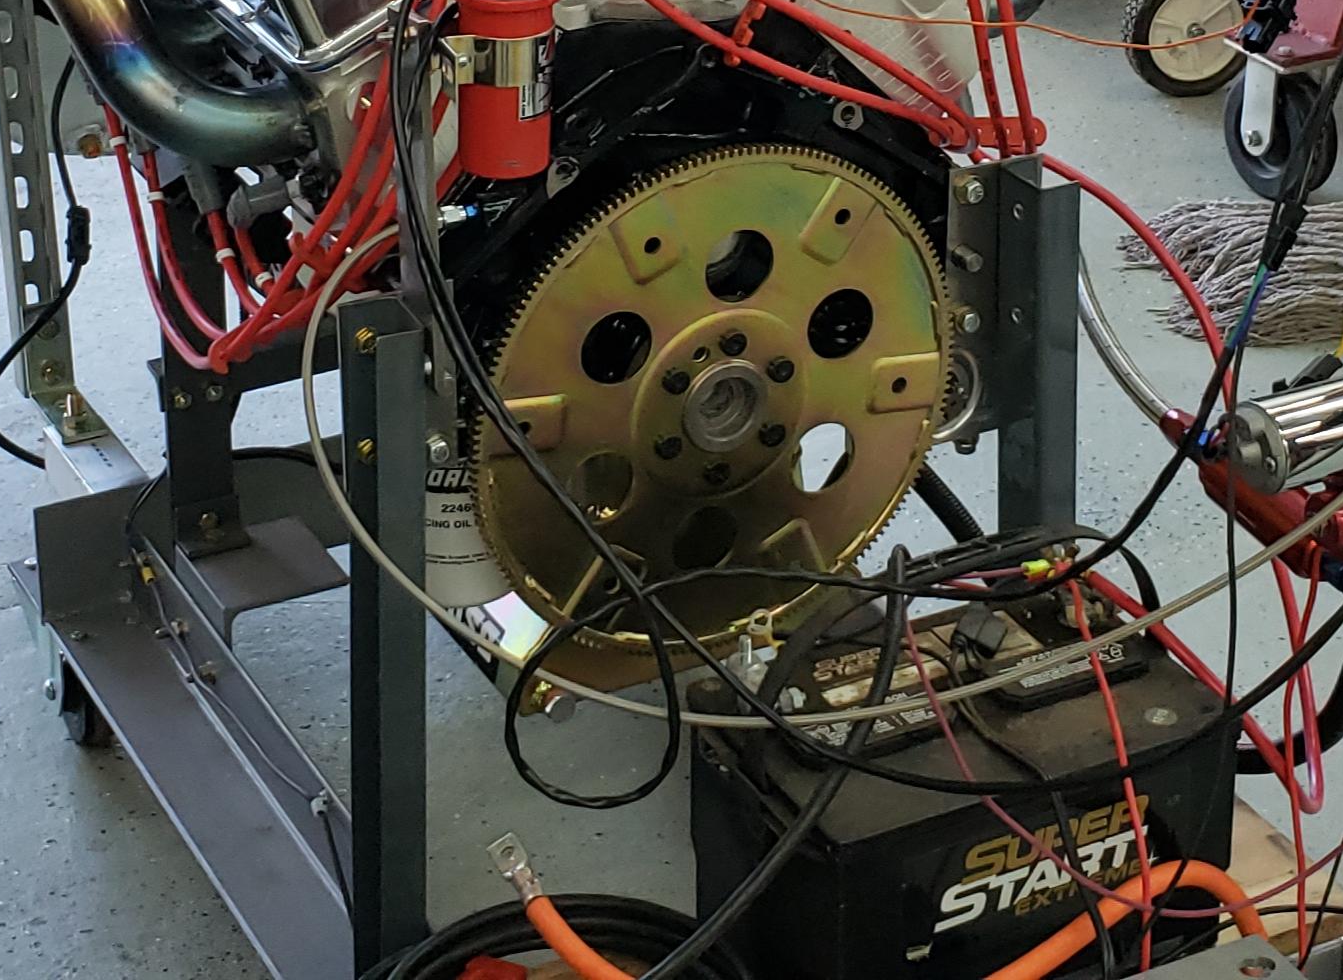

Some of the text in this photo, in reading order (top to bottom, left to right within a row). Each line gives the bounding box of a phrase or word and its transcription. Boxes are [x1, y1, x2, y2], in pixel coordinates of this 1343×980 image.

[425, 518, 472, 529] CING OIL
[440, 503, 474, 513] 2246
[962, 795, 1150, 885] SUPER
[934, 826, 1149, 933] START
